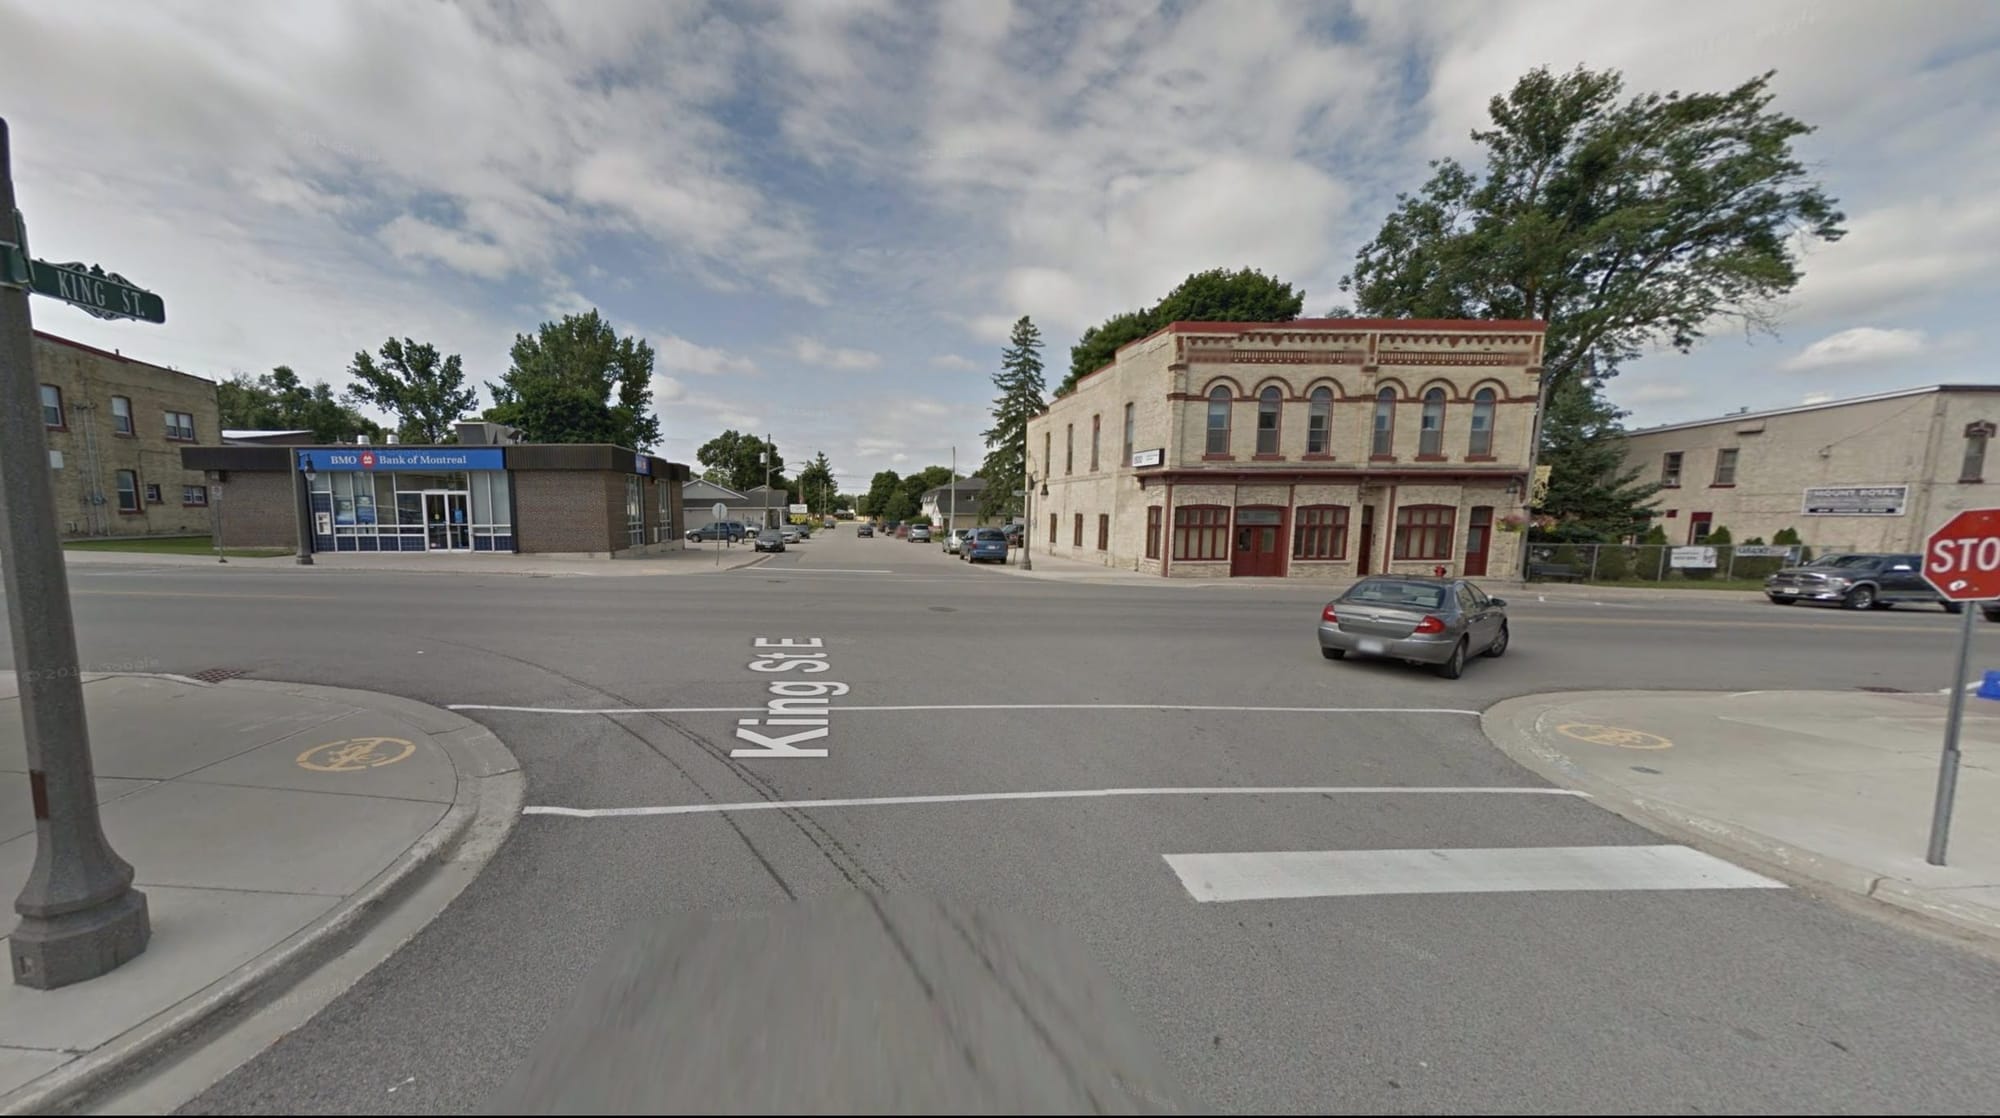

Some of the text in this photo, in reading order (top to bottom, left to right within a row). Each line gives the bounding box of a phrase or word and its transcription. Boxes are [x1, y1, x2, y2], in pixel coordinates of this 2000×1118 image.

[56, 270, 145, 317] KING ST.
[331, 455, 467, 465] BMO Bank of Montreal
[1931, 537, 2000, 573] STO
